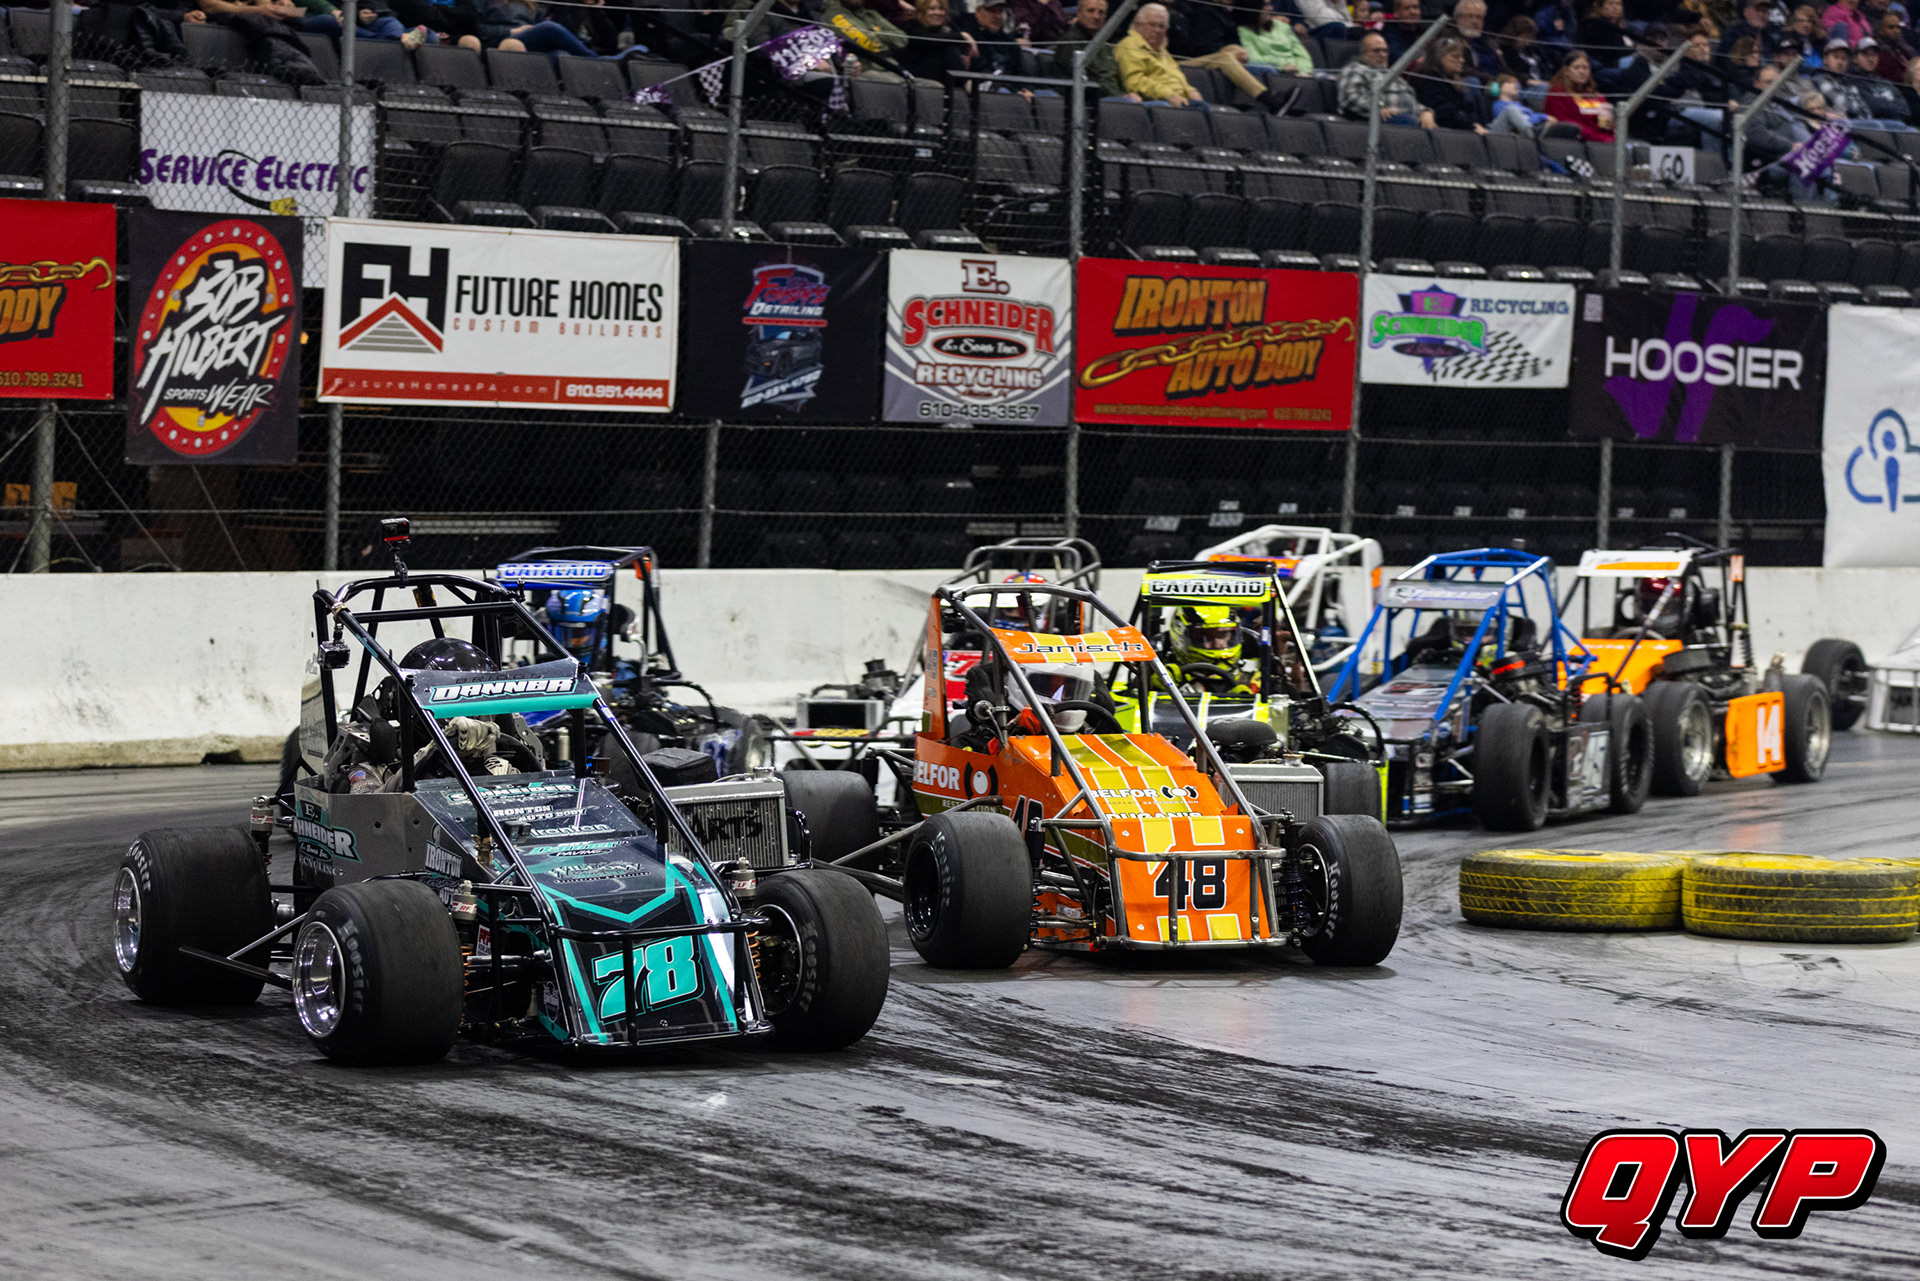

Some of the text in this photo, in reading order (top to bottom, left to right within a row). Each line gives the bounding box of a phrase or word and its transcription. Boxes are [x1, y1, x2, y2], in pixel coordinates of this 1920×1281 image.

[140, 148, 369, 193] SERVICE ELECTRC
[183, 258, 266, 324] BOB
[454, 274, 664, 323] FUTURE HOMES
[961, 259, 1010, 295] E.
[902, 297, 1057, 357] SCHNEIDER
[1114, 276, 1268, 333] IRONTON
[1470, 298, 1569, 315] RECYCLING
[452, 317, 664, 339] CUSTOM BUILDERS
[136, 313, 286, 425] HILBERT
[915, 361, 1043, 391] RECYCLING
[1165, 339, 1325, 397] AUTO BODY
[1605, 336, 1803, 390] HOOSIER
[565, 383, 664, 400] 610.951.4444
[919, 402, 1040, 420] 610-435-3527
[1016, 640, 1143, 654] Janisch
[431, 678, 577, 702] DANNER
[493, 805, 551, 816] RONTON
[1153, 858, 1227, 912] 48
[592, 932, 703, 1022] 78
